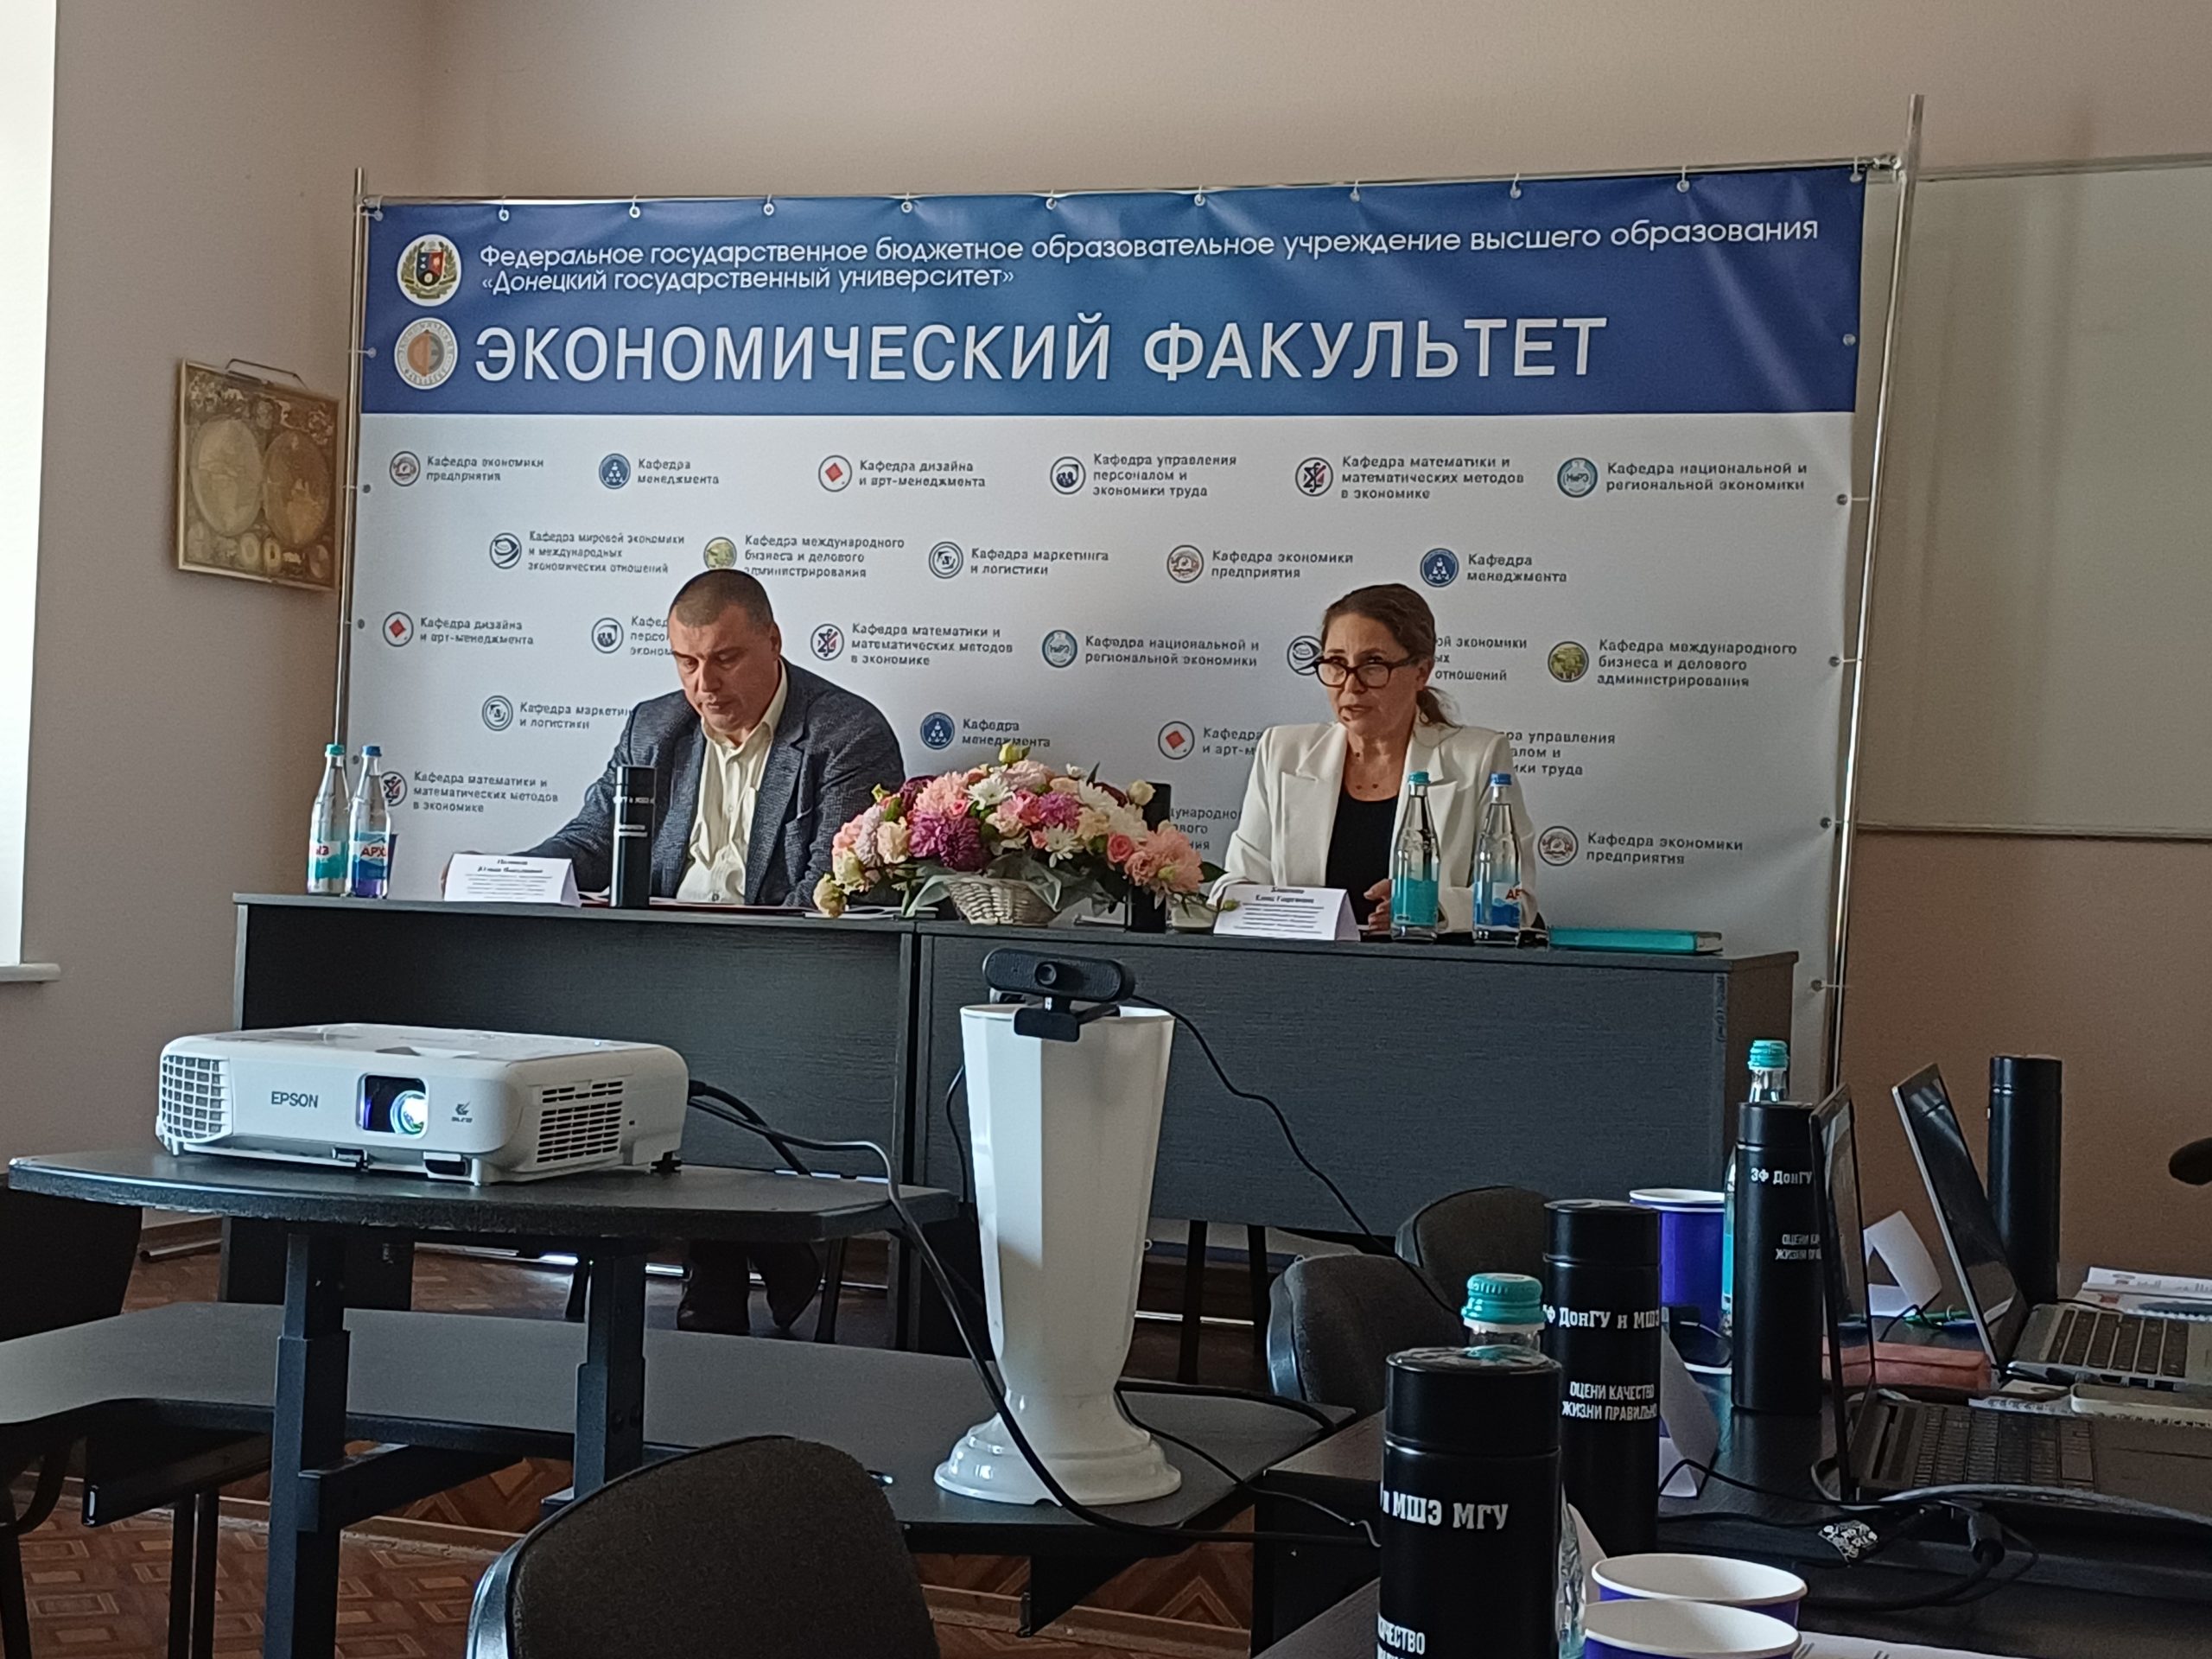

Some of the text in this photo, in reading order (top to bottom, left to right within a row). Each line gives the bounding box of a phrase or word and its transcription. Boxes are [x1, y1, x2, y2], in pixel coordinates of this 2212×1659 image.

[480, 219, 1817, 271] Федеральное государственное бюджетное образовательное учреждение высшего образования
[483, 267, 1014, 295] «Донецкий государственный университет»
[476, 313, 1109, 381] ЭКОНОМИЧЕСКИЙ
[1145, 318, 1606, 381] ФАКУЛЬТЕТ
[428, 456, 477, 467] Кафедра
[639, 459, 690, 471] Кафедра
[861, 461, 973, 473] Кафедра дизайна
[1094, 454, 1236, 467] Кафедра управления
[1343, 456, 1404, 469] Кафедра
[1410, 459, 1496, 467] математики
[1608, 463, 1807, 475] Кафедра национальной и
[638, 475, 719, 484] менеджмента
[871, 478, 985, 487] арт-менеджмента
[1094, 472, 1173, 482] персоналом
[1343, 474, 1523, 484] математических методов
[1093, 486, 1207, 499] экономики труда
[1606, 480, 1804, 493] региональной экономики
[1341, 490, 1430, 499] в экономике
[530, 531, 684, 544] Кафедра мировой экономики
[746, 535, 904, 549] Кафедра международного
[745, 550, 792, 561] бизнеса
[809, 554, 864, 563] делового
[972, 548, 1109, 562] Кафедра маркетинга
[1213, 550, 1353, 563] Кафедра экономики
[1469, 554, 1532, 568] Кафедра
[610, 563, 668, 573] отношений
[971, 565, 1048, 575] и логистики
[1211, 569, 1300, 579] предприятия
[1467, 573, 1567, 582] менеджмента
[421, 617, 522, 630] Кафедра дизайна
[631, 616, 668, 628] Кафед
[853, 623, 1000, 638] Кафедра математики и
[852, 640, 1013, 653] математических методов
[1086, 636, 1144, 649] Кафедра
[1149, 639, 1245, 650] национальной
[1456, 639, 1527, 648] экономики
[1599, 639, 1796, 656] Кафедра международного
[862, 656, 930, 665] экономике
[1086, 653, 1256, 666] региональной экономики
[1599, 655, 1658, 668] бизнеса
[1677, 660, 1746, 671] делового
[1435, 670, 1506, 680] отношений
[1598, 675, 1749, 688] администрирования
[520, 702, 571, 715] Кафедра
[531, 719, 589, 729] логистики
[963, 719, 1019, 732] Кафедра
[1203, 728, 1262, 741] Кафедра
[1529, 733, 1615, 744] управления
[1541, 766, 1582, 777] труда
[414, 771, 463, 785] Кафедра
[468, 776, 536, 786] математики
[413, 787, 558, 802] математических методов
[423, 802, 483, 812] экономике
[1588, 833, 1742, 850] Кафедра экономики
[1586, 852, 1684, 864] предприятия
[271, 1091, 318, 1108] EPSON
[1773, 1170, 1813, 1185] ДонГУ
[1559, 1306, 1611, 1328] ДонГУ
[1569, 1381, 1655, 1400] ОЦЕНИ КАЧЕСТВО
[1561, 1401, 1602, 1420] ЖИЗНИ
[1392, 1491, 1442, 1526] МШЭ
[1452, 1503, 1509, 1530] МГУ
